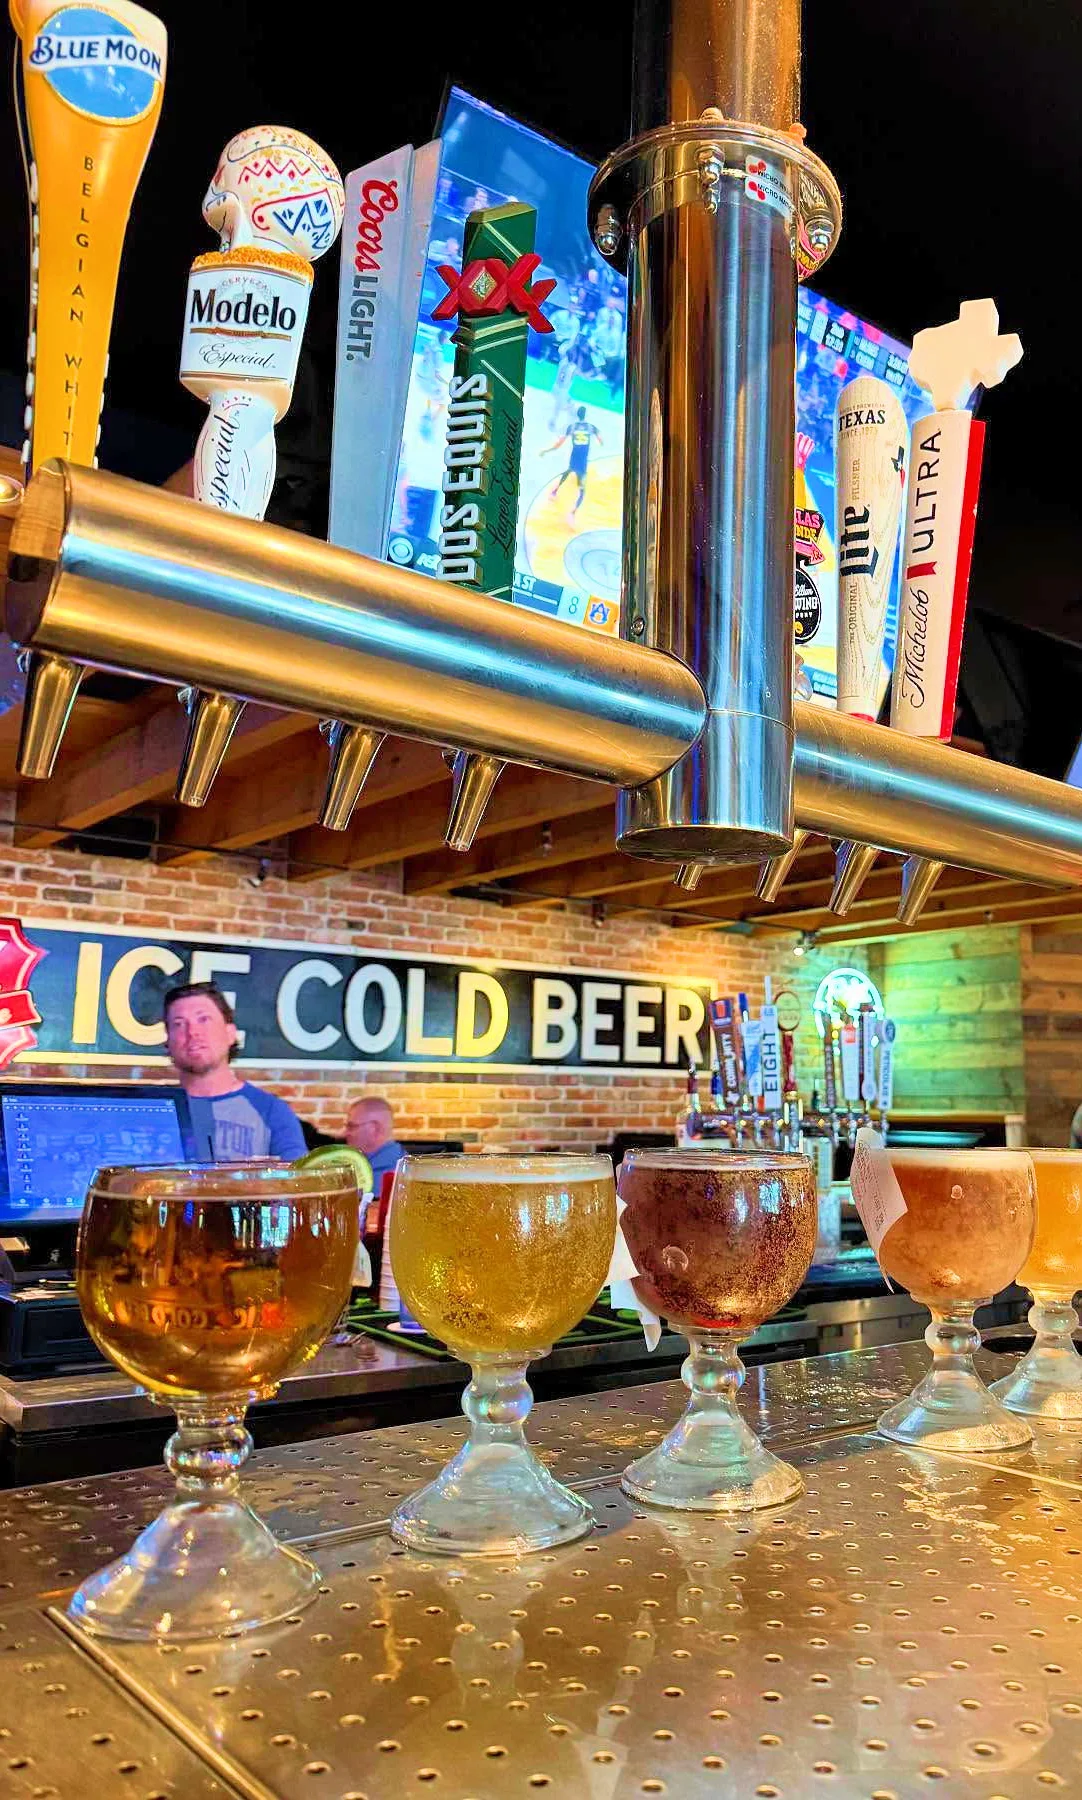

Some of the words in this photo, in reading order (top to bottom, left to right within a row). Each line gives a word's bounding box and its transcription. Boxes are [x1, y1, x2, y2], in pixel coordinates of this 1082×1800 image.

[29, 36, 100, 65] BLUE
[105, 38, 161, 73] MOON
[70, 156, 94, 325] BELGIAN
[354, 179, 399, 273] Coors
[189, 288, 297, 331] Modelo
[198, 343, 277, 369] Especial
[442, 372, 491, 495] EQUIS
[838, 409, 886, 433] TEXAS
[209, 412, 241, 510] special
[852, 457, 861, 501] PILSNER
[912, 430, 942, 554] ULTRA
[436, 502, 484, 584] DOS
[795, 510, 821, 529] LAS
[839, 504, 880, 579] Lite
[849, 581, 859, 630] ORIGINAL
[902, 587, 930, 710] Michelob
[276, 958, 510, 1059] COLD
[532, 977, 705, 1065] BEER
[762, 1030, 779, 1092] EIGHT
